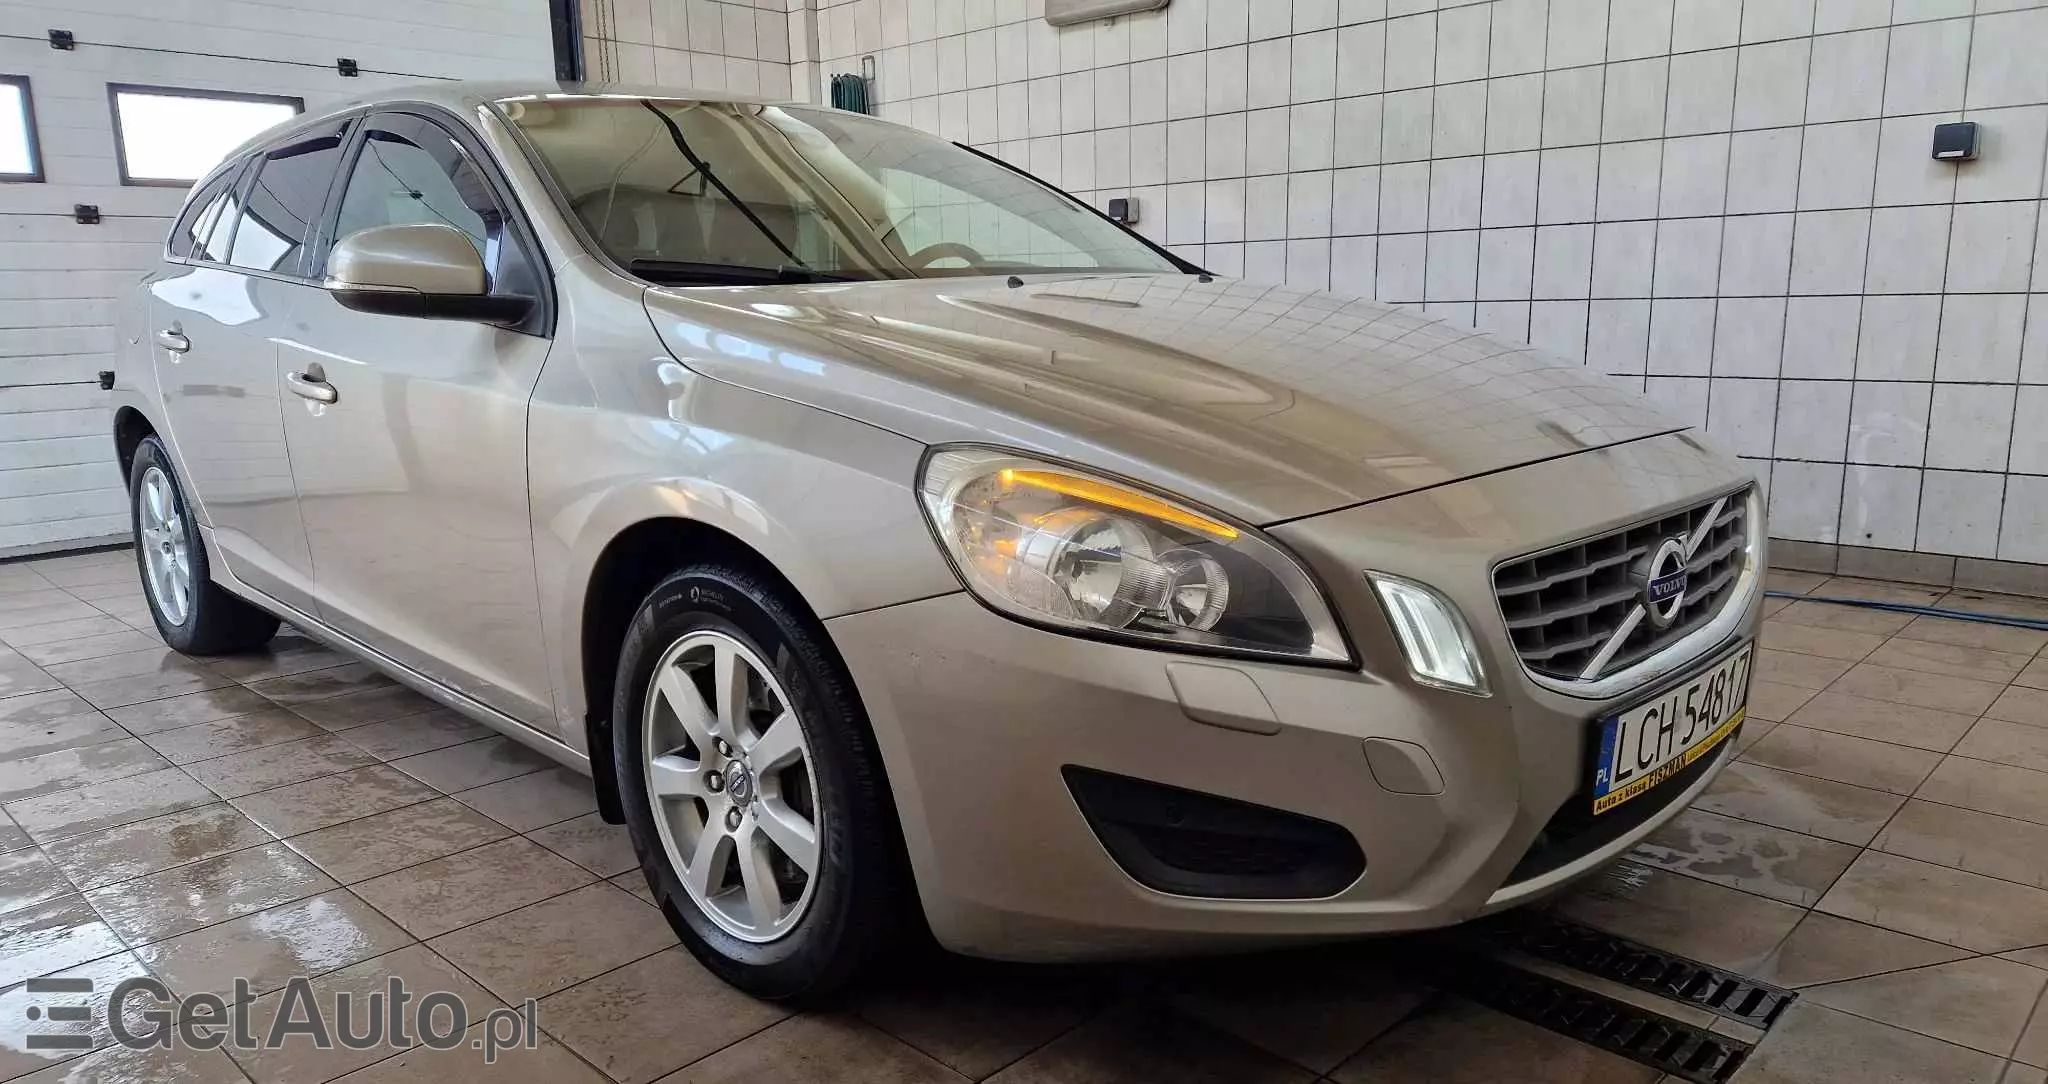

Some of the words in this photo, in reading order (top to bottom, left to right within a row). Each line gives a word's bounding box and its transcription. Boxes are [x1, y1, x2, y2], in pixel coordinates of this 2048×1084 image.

[1614, 695, 1678, 783] LCH
[1681, 650, 1750, 745] 54817
[1595, 767, 1609, 787] PL
